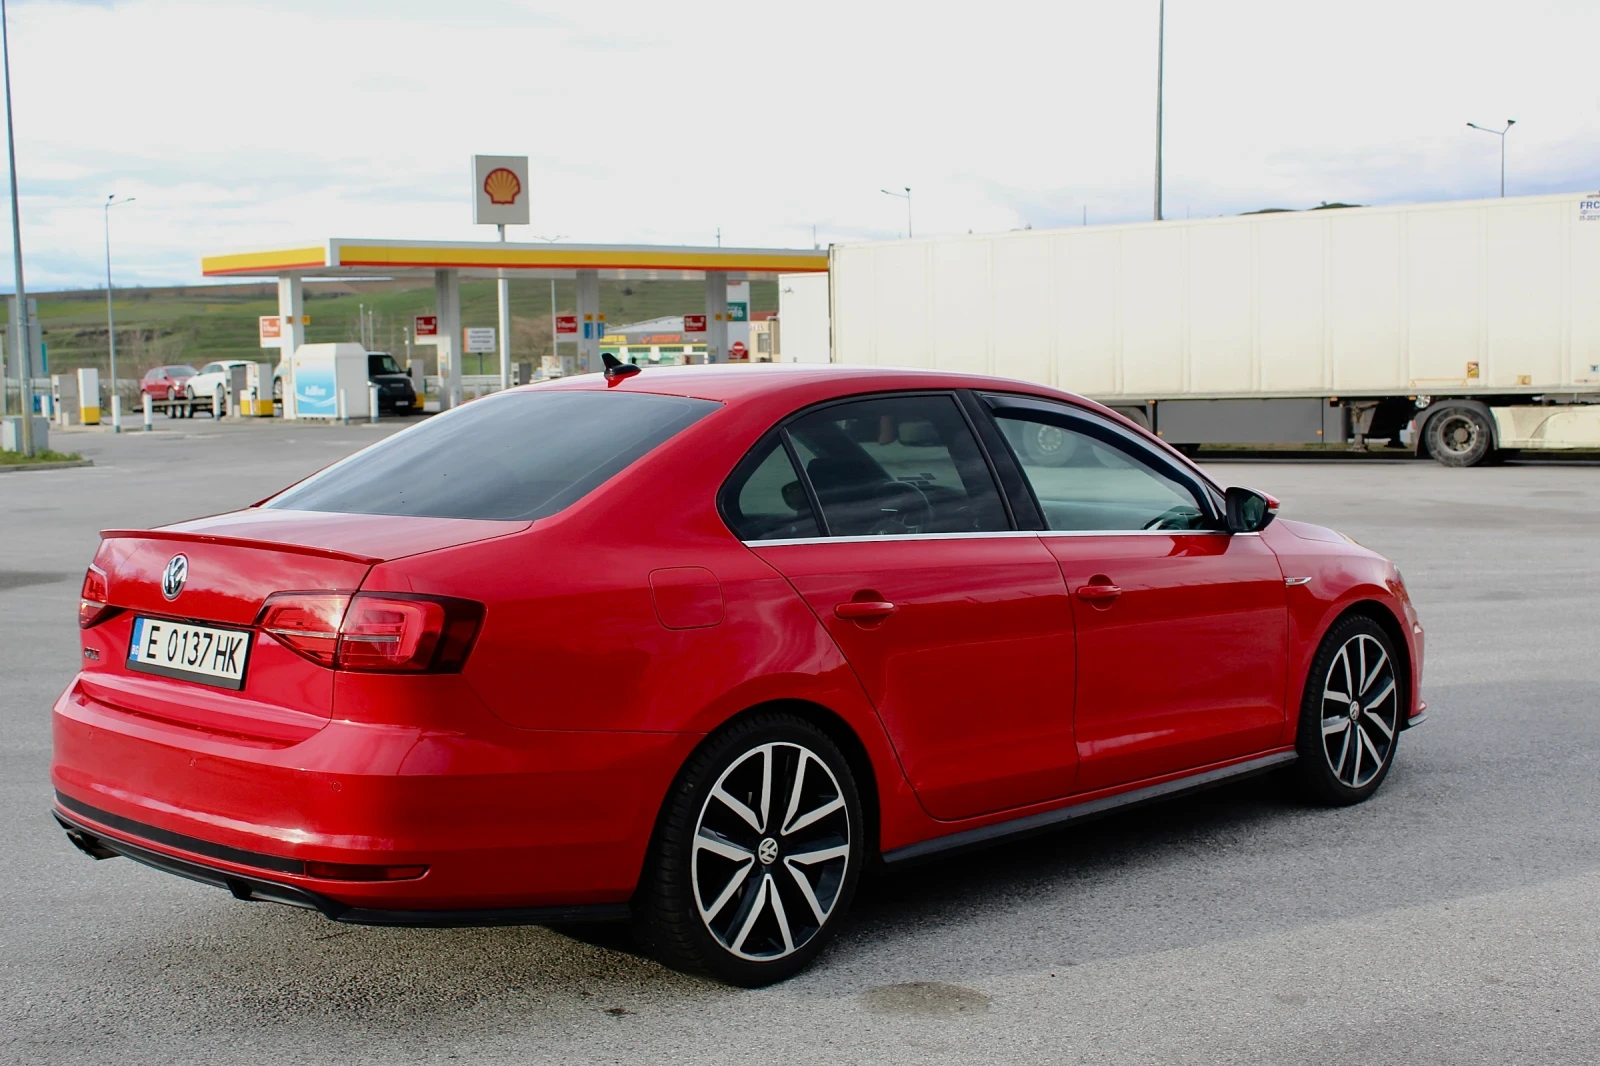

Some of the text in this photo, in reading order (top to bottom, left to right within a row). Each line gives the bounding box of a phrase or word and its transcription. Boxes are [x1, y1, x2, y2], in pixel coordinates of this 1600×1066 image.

[146, 625, 243, 674] E 0137 HK
